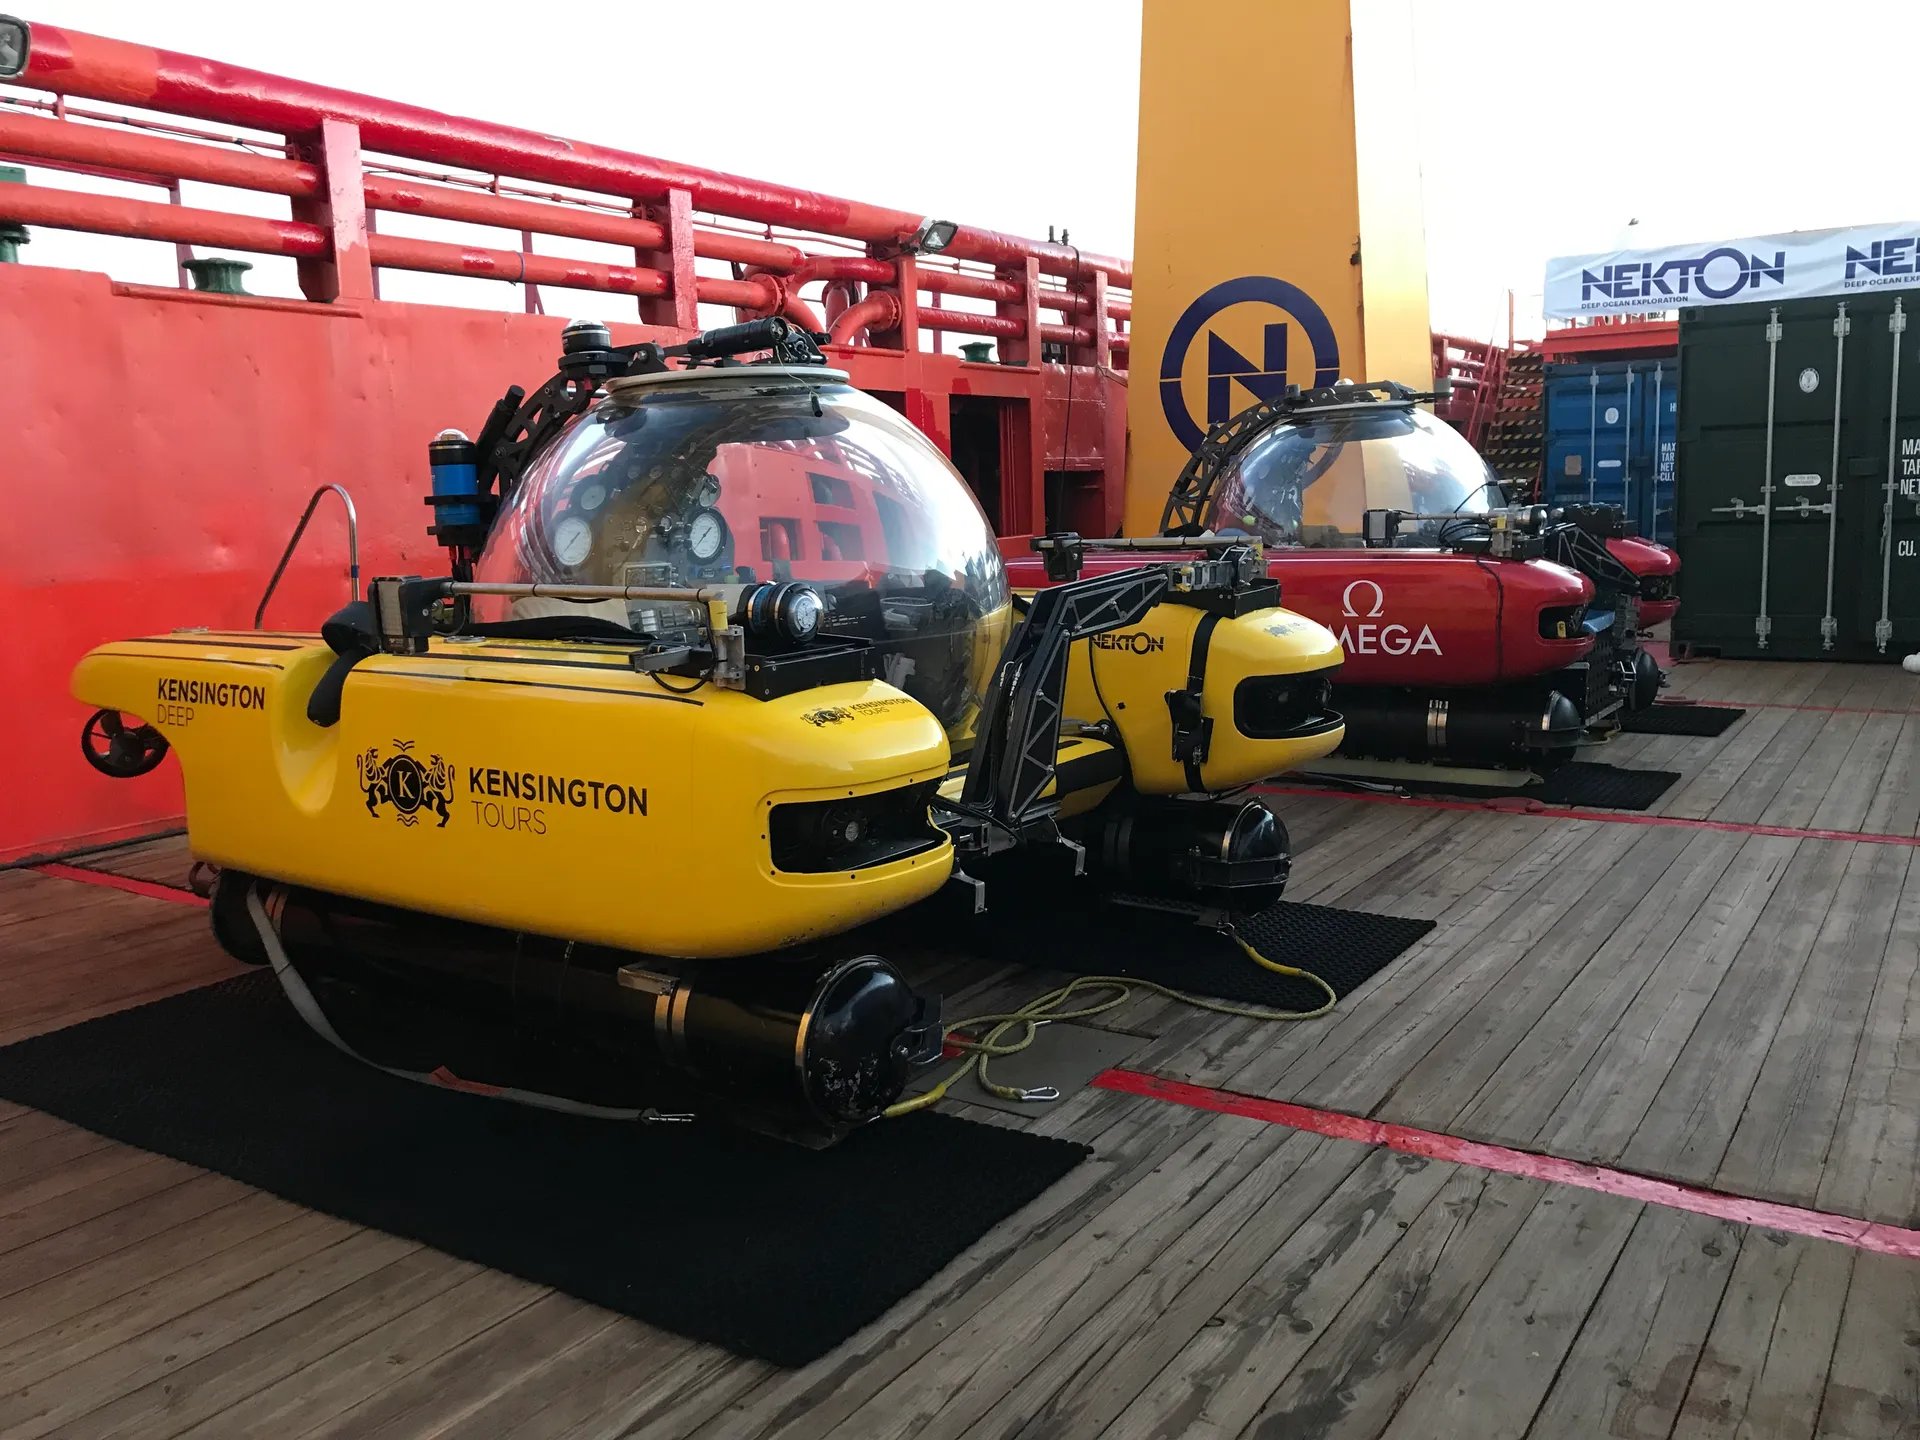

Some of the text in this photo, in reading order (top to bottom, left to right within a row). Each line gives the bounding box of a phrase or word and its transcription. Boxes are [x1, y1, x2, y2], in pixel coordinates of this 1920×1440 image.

[1582, 247, 1785, 300] NEKTON
[1844, 280, 1868, 288] DEEP
[1869, 276, 1902, 286] OCEAN
[1602, 299, 1630, 308] OCEAN
[1632, 296, 1689, 306] EXPLORATION
[1661, 442, 1676, 452] MAX
[1661, 452, 1675, 462] TAR
[1660, 462, 1675, 472] NET
[1898, 540, 1917, 556] CU.
[1327, 623, 1443, 656] MEGA
[157, 677, 266, 710] KENSINGTON
[849, 698, 913, 711] KENSINGTON
[857, 707, 890, 717] TOURS
[157, 703, 195, 727] DEEP
[398, 770, 416, 799] K
[469, 766, 648, 817] KENSINGTON
[471, 800, 547, 835] TOURS
